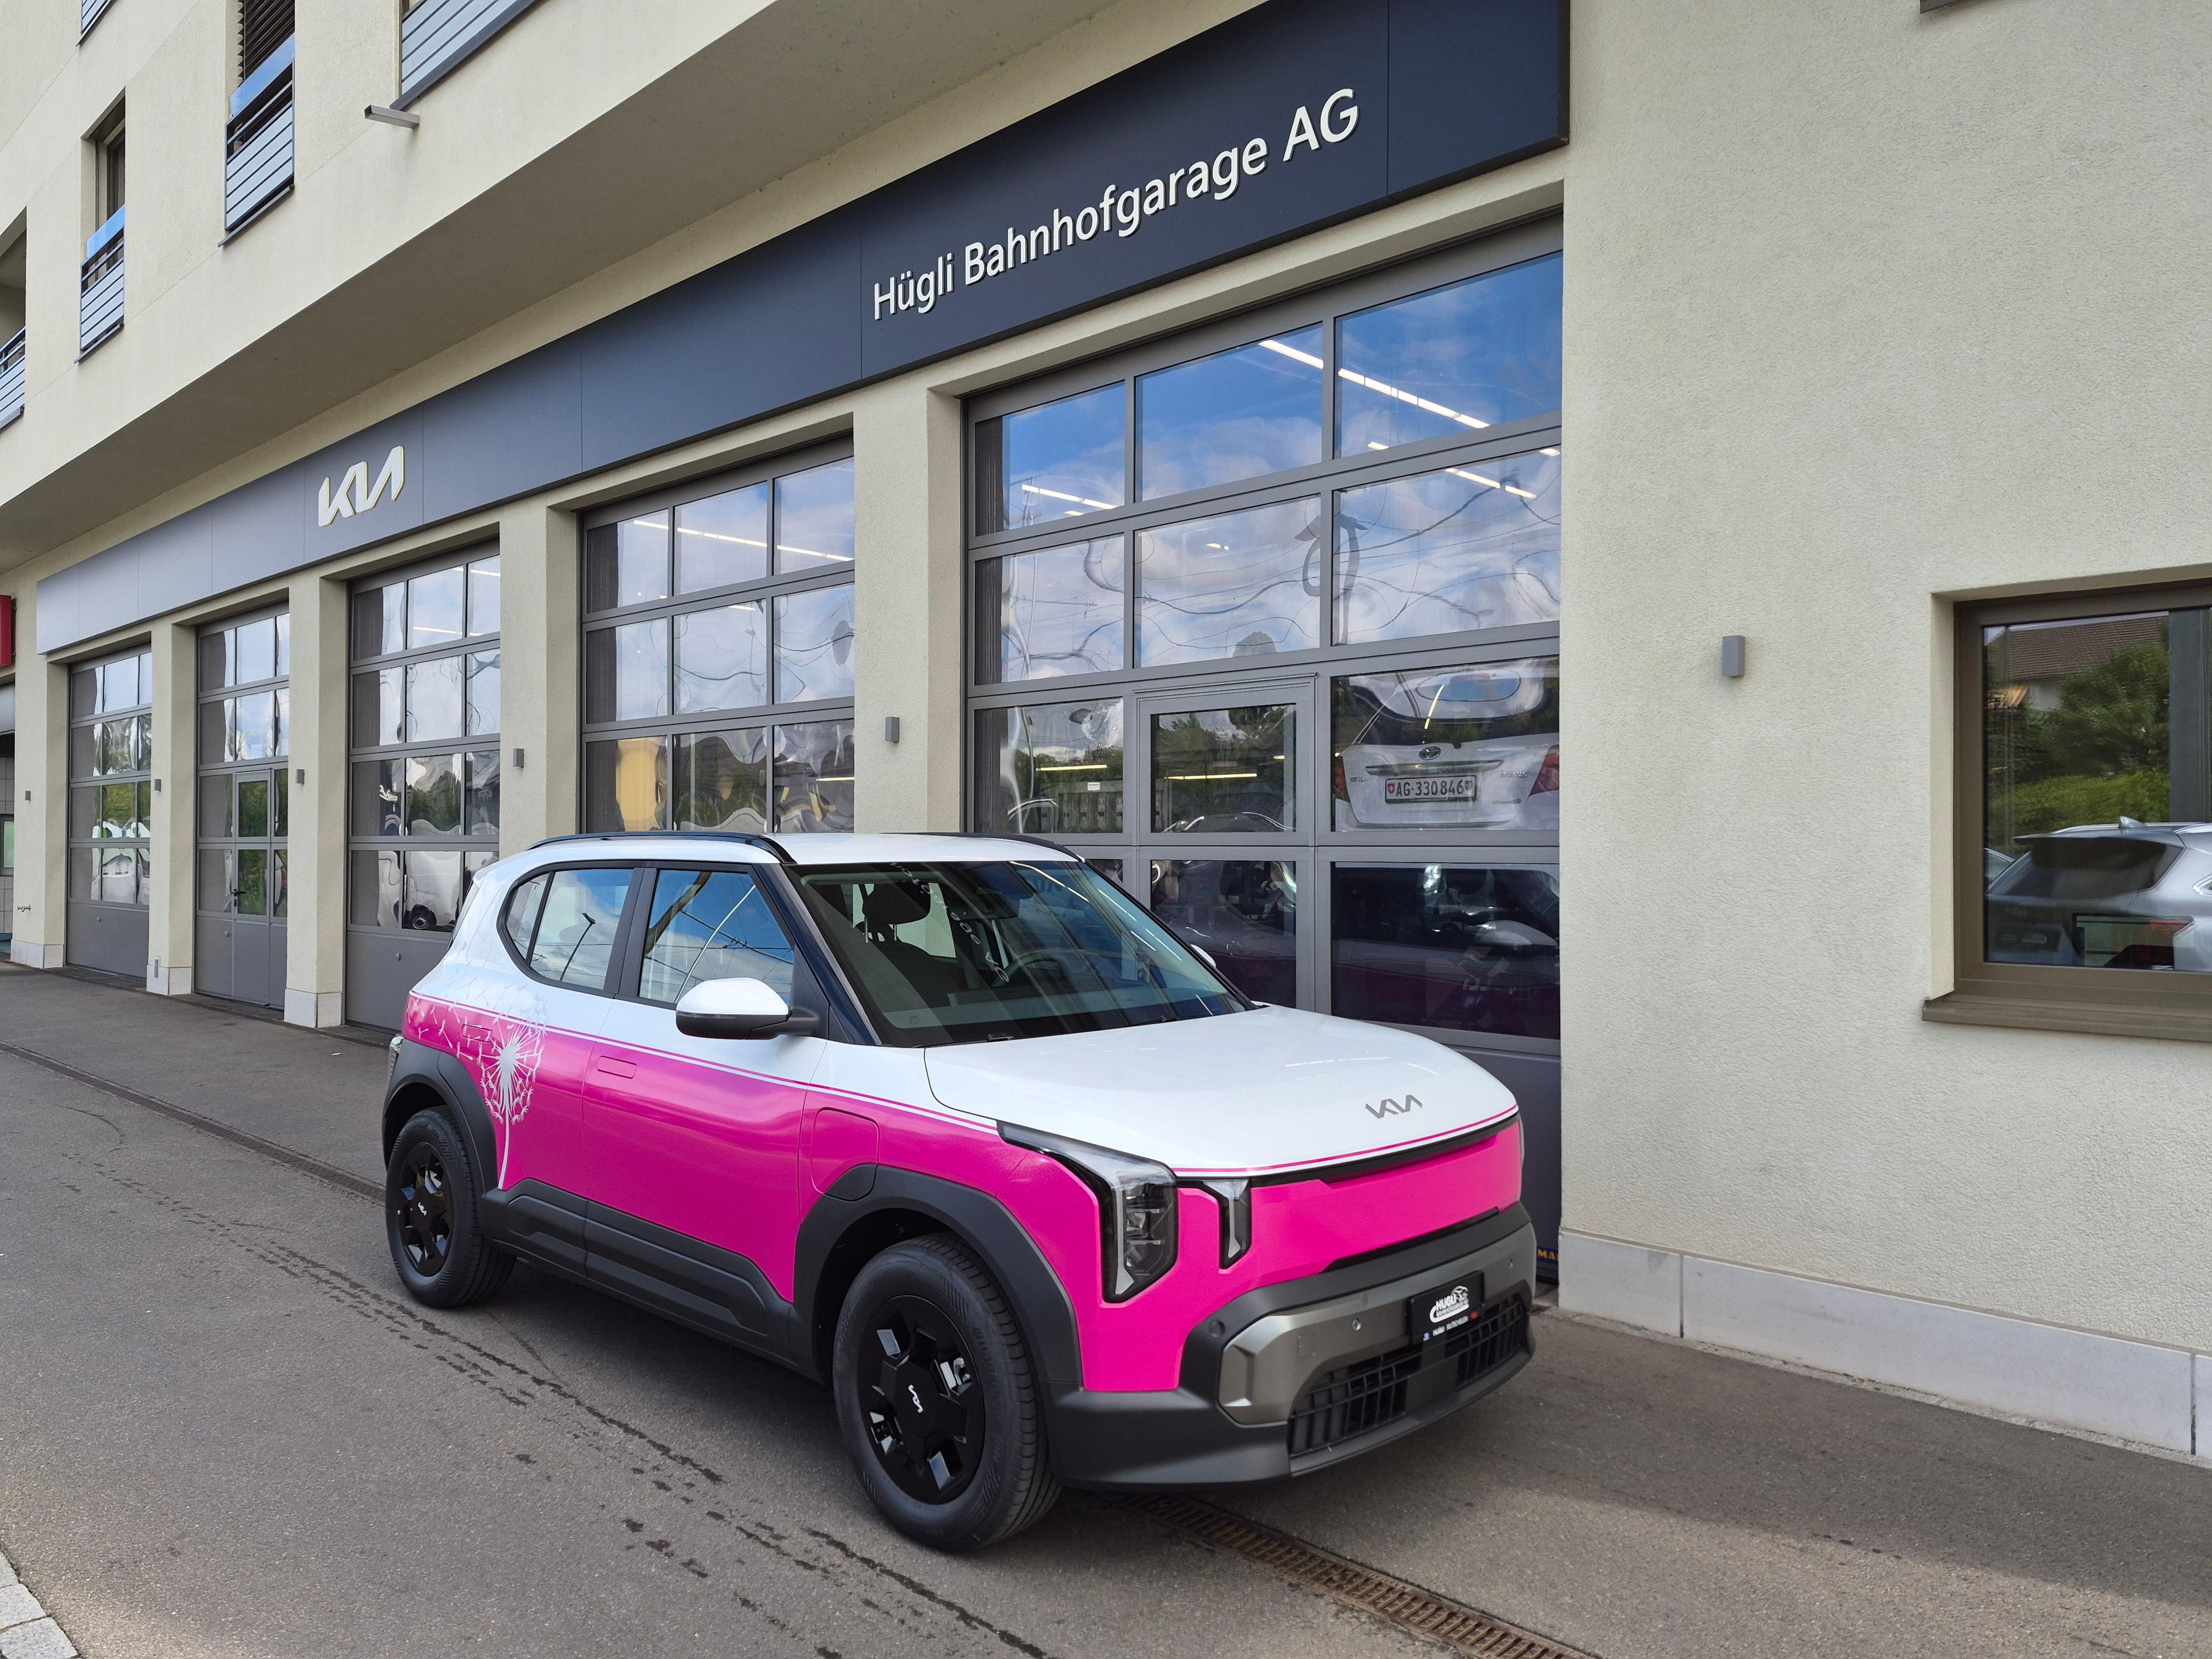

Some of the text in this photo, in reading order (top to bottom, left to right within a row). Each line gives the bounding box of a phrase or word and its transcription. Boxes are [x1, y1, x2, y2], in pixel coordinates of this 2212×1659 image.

[873, 88, 1360, 320] Hügli Bahnhofgarage AG
[318, 446, 405, 527] KIA
[1365, 1094, 1423, 1119] KIA
